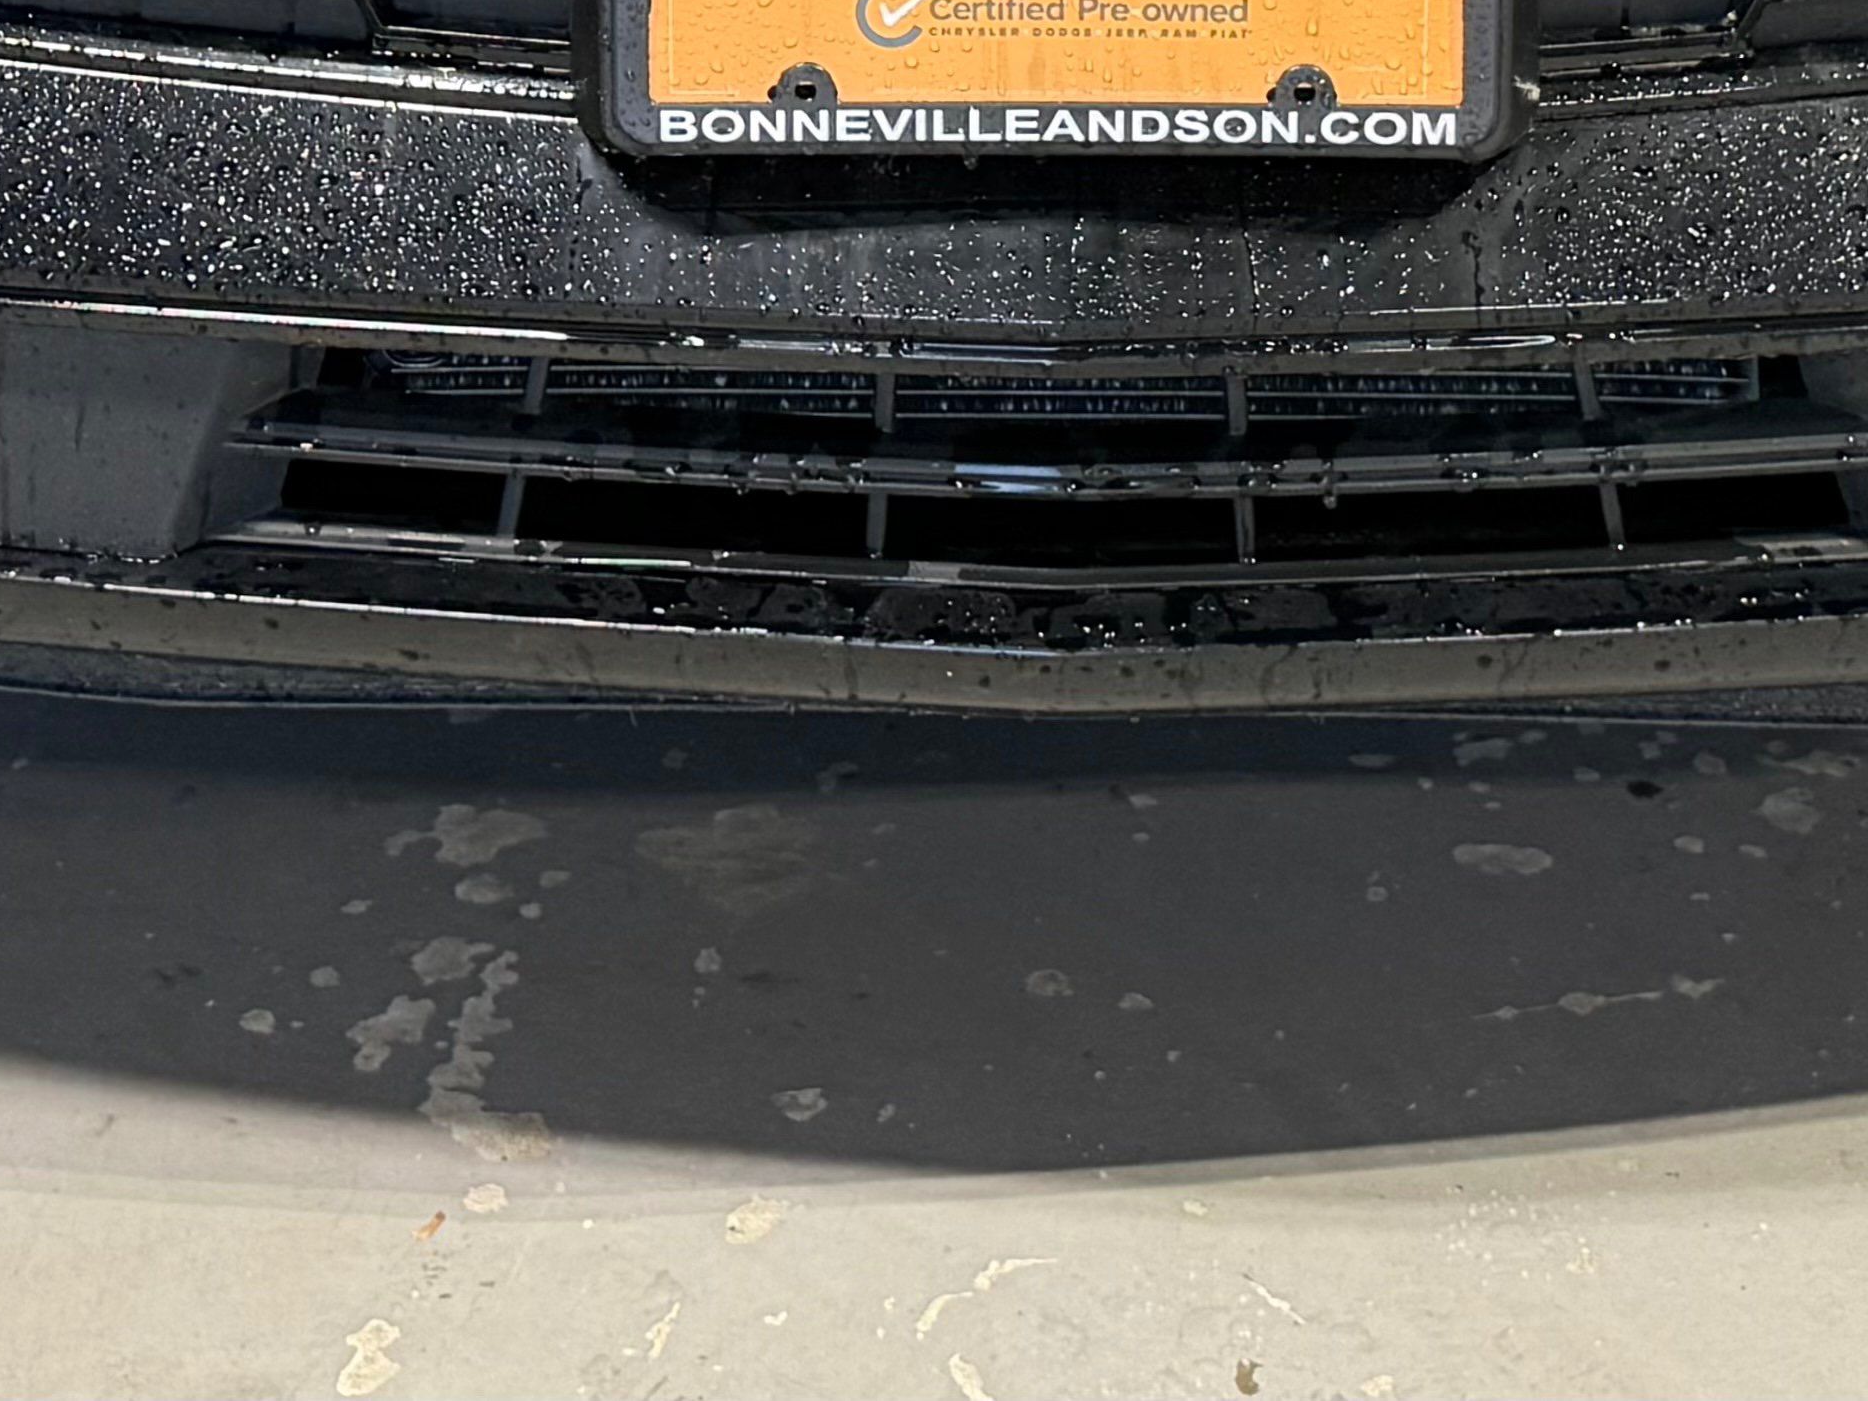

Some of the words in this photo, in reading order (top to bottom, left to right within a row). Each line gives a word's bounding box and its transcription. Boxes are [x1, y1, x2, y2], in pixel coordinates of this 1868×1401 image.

[928, 26, 1020, 38] CHRYSLER
[1032, 27, 1093, 39] DODGE
[1159, 28, 1198, 39] RAM
[658, 108, 1458, 147] BONNEVILLEANDSON.COM
